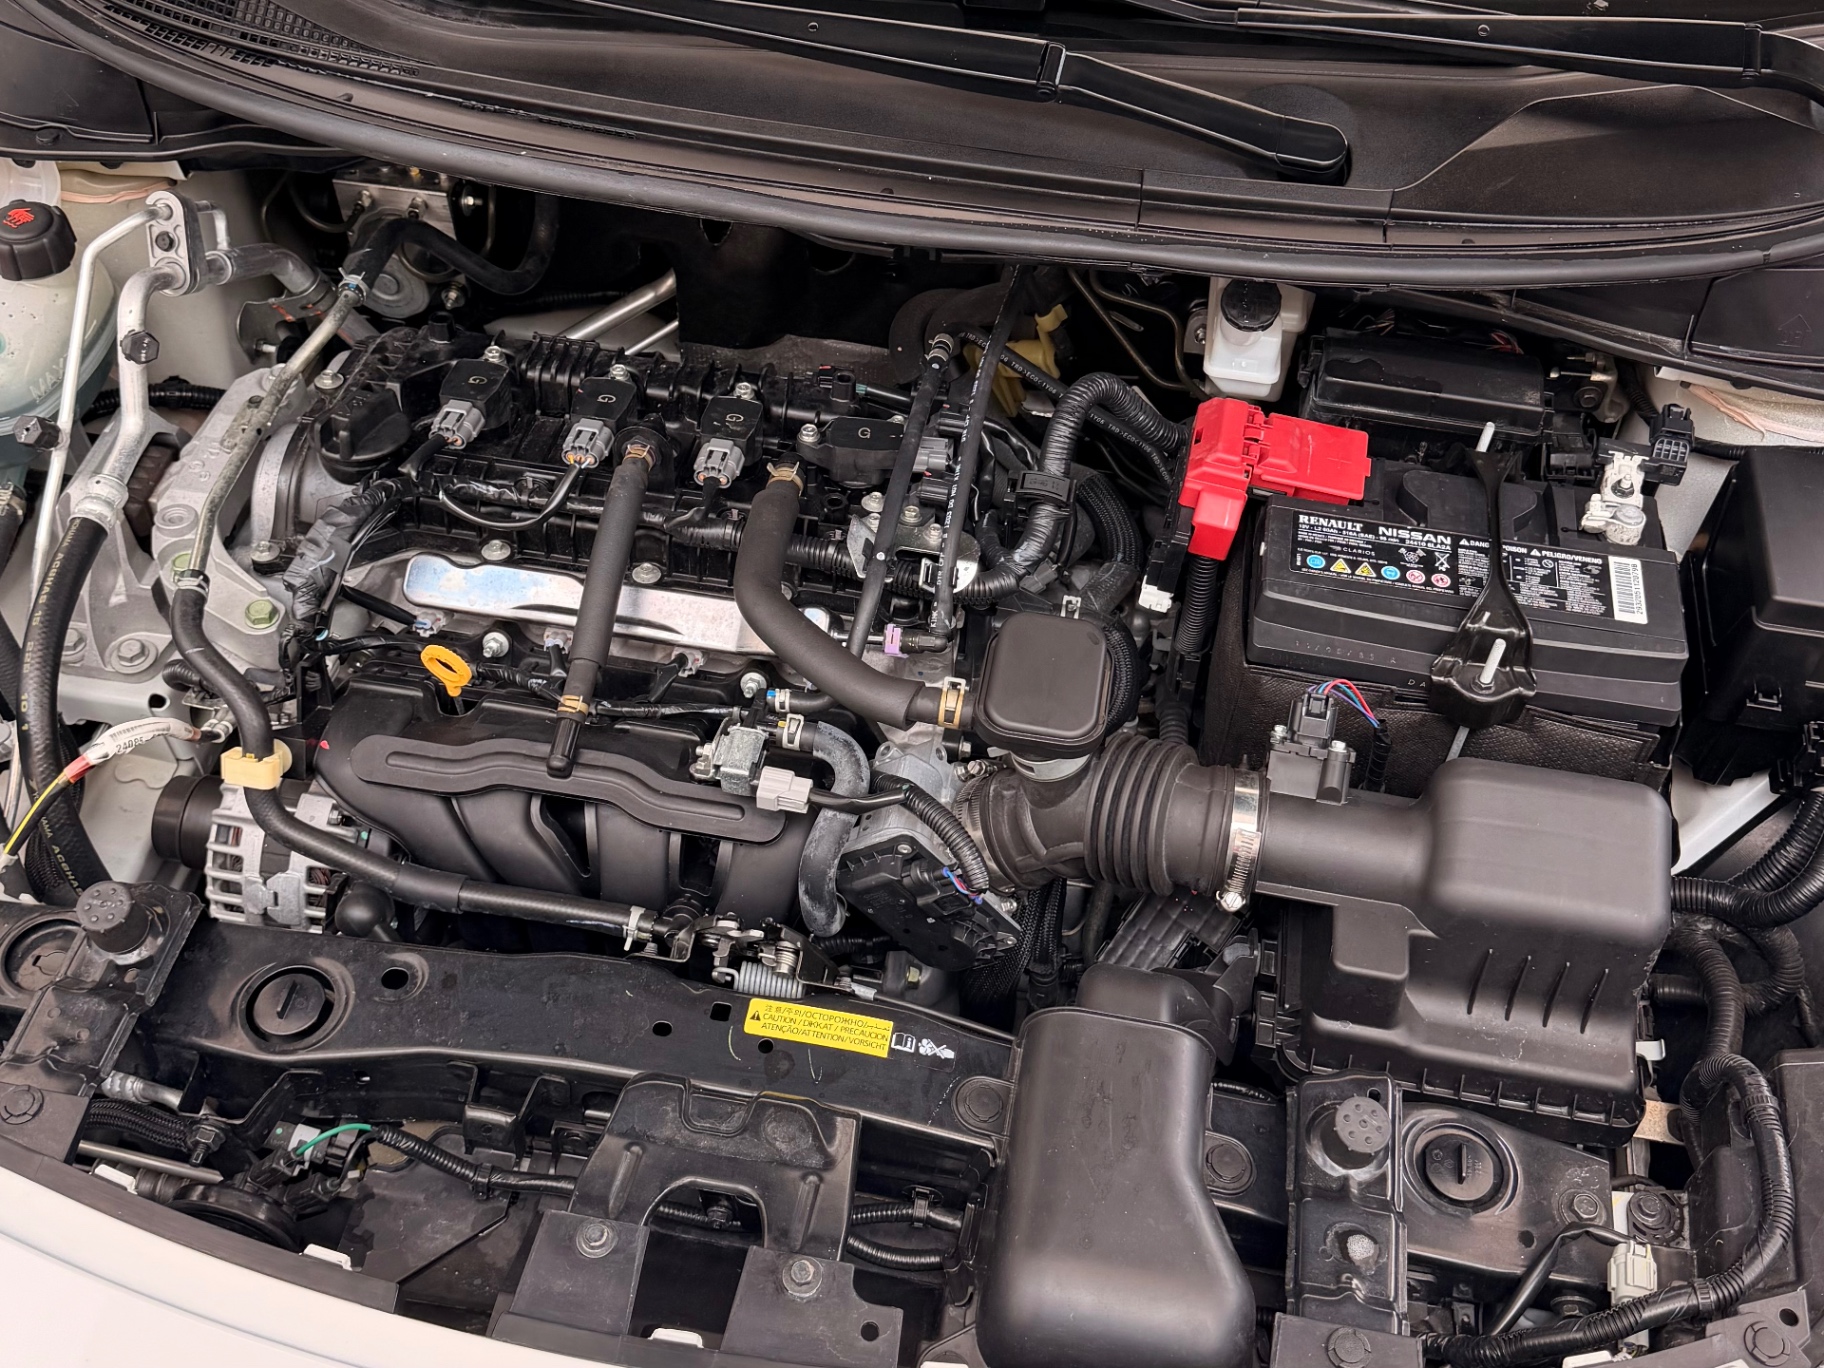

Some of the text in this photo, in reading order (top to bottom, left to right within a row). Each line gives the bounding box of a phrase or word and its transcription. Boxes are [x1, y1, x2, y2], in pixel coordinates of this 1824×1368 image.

[467, 375, 488, 385] G
[597, 394, 616, 404] G
[725, 413, 744, 422] G
[857, 427, 871, 439] G
[1298, 514, 1363, 532] RENAULT
[1378, 526, 1452, 545] NISSAN
[1342, 546, 1376, 557] CLARIOS
[1541, 550, 1603, 565] PELIGRO/VENENO
[762, 1013, 797, 1025] CAUTION
